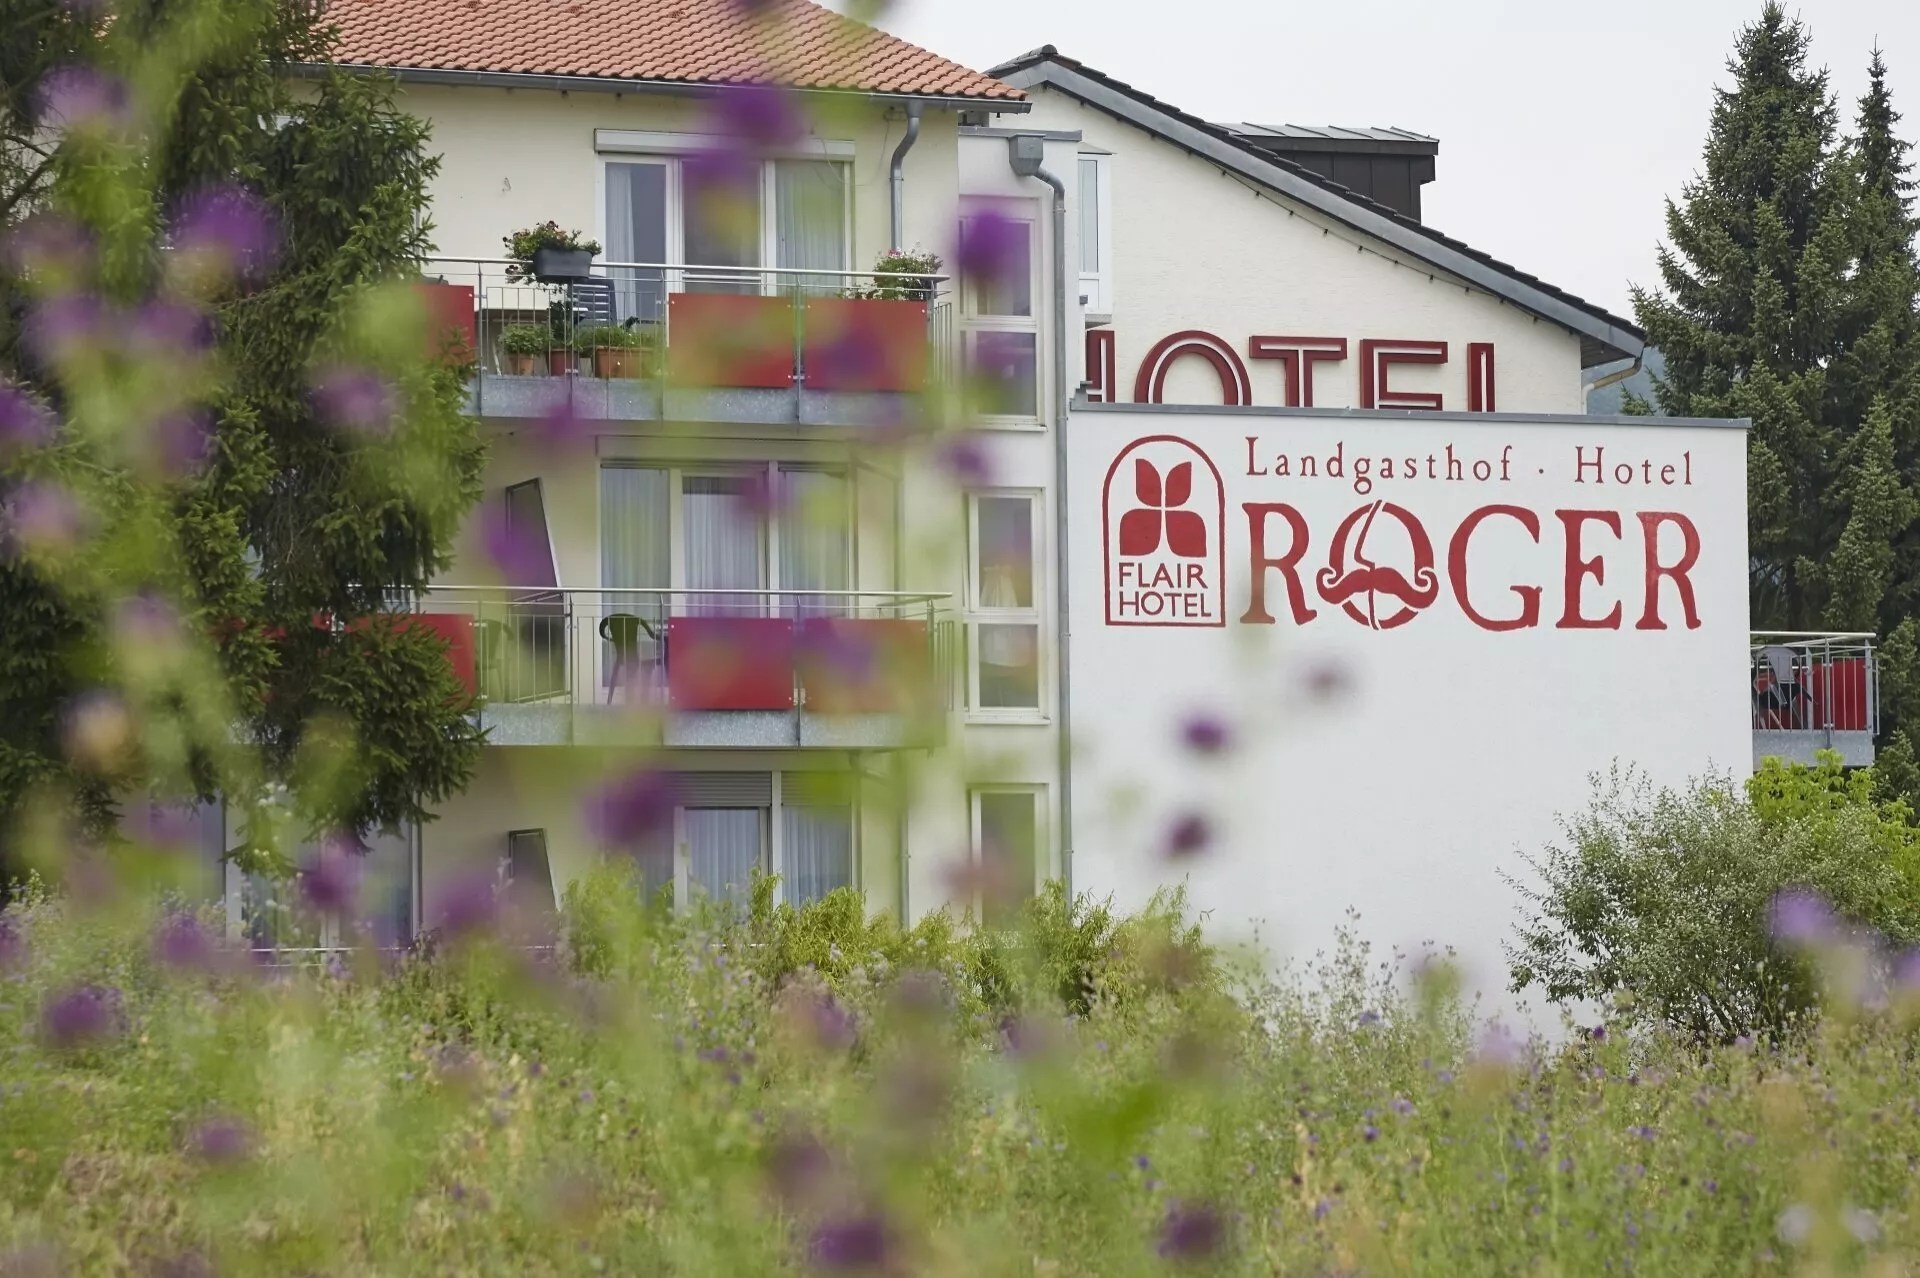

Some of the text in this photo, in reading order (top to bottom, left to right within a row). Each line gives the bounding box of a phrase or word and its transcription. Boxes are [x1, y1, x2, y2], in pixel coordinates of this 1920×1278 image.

[1087, 330, 1495, 411] OTE
[1245, 436, 1513, 495] Landgasthof
[1575, 446, 1692, 485] Hotel
[1118, 562, 1209, 589] FLAIR
[1240, 500, 1702, 632] ROGER
[1118, 591, 1212, 618] HOTEL
